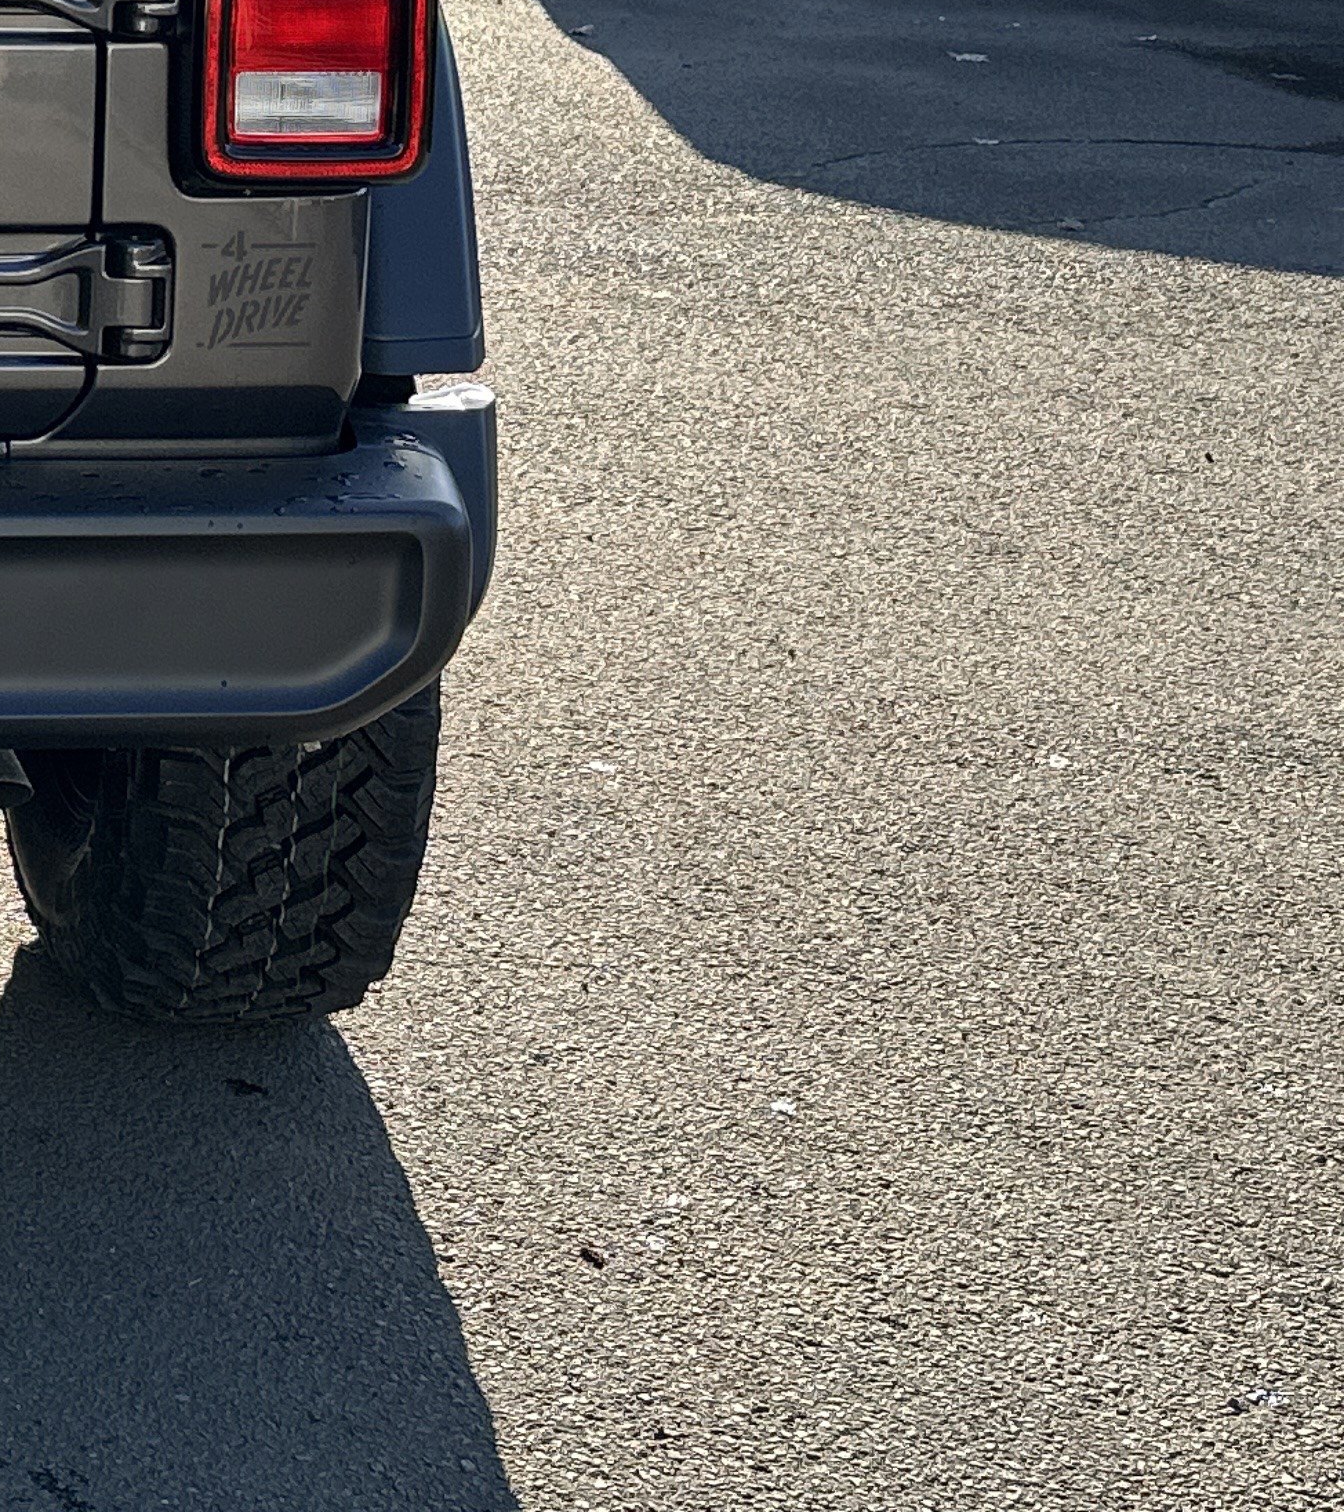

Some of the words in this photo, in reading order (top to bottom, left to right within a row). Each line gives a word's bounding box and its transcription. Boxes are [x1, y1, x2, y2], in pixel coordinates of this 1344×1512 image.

[220, 230, 248, 262] 4
[207, 255, 313, 307] WHEEL
[207, 293, 312, 350] DRIVE
